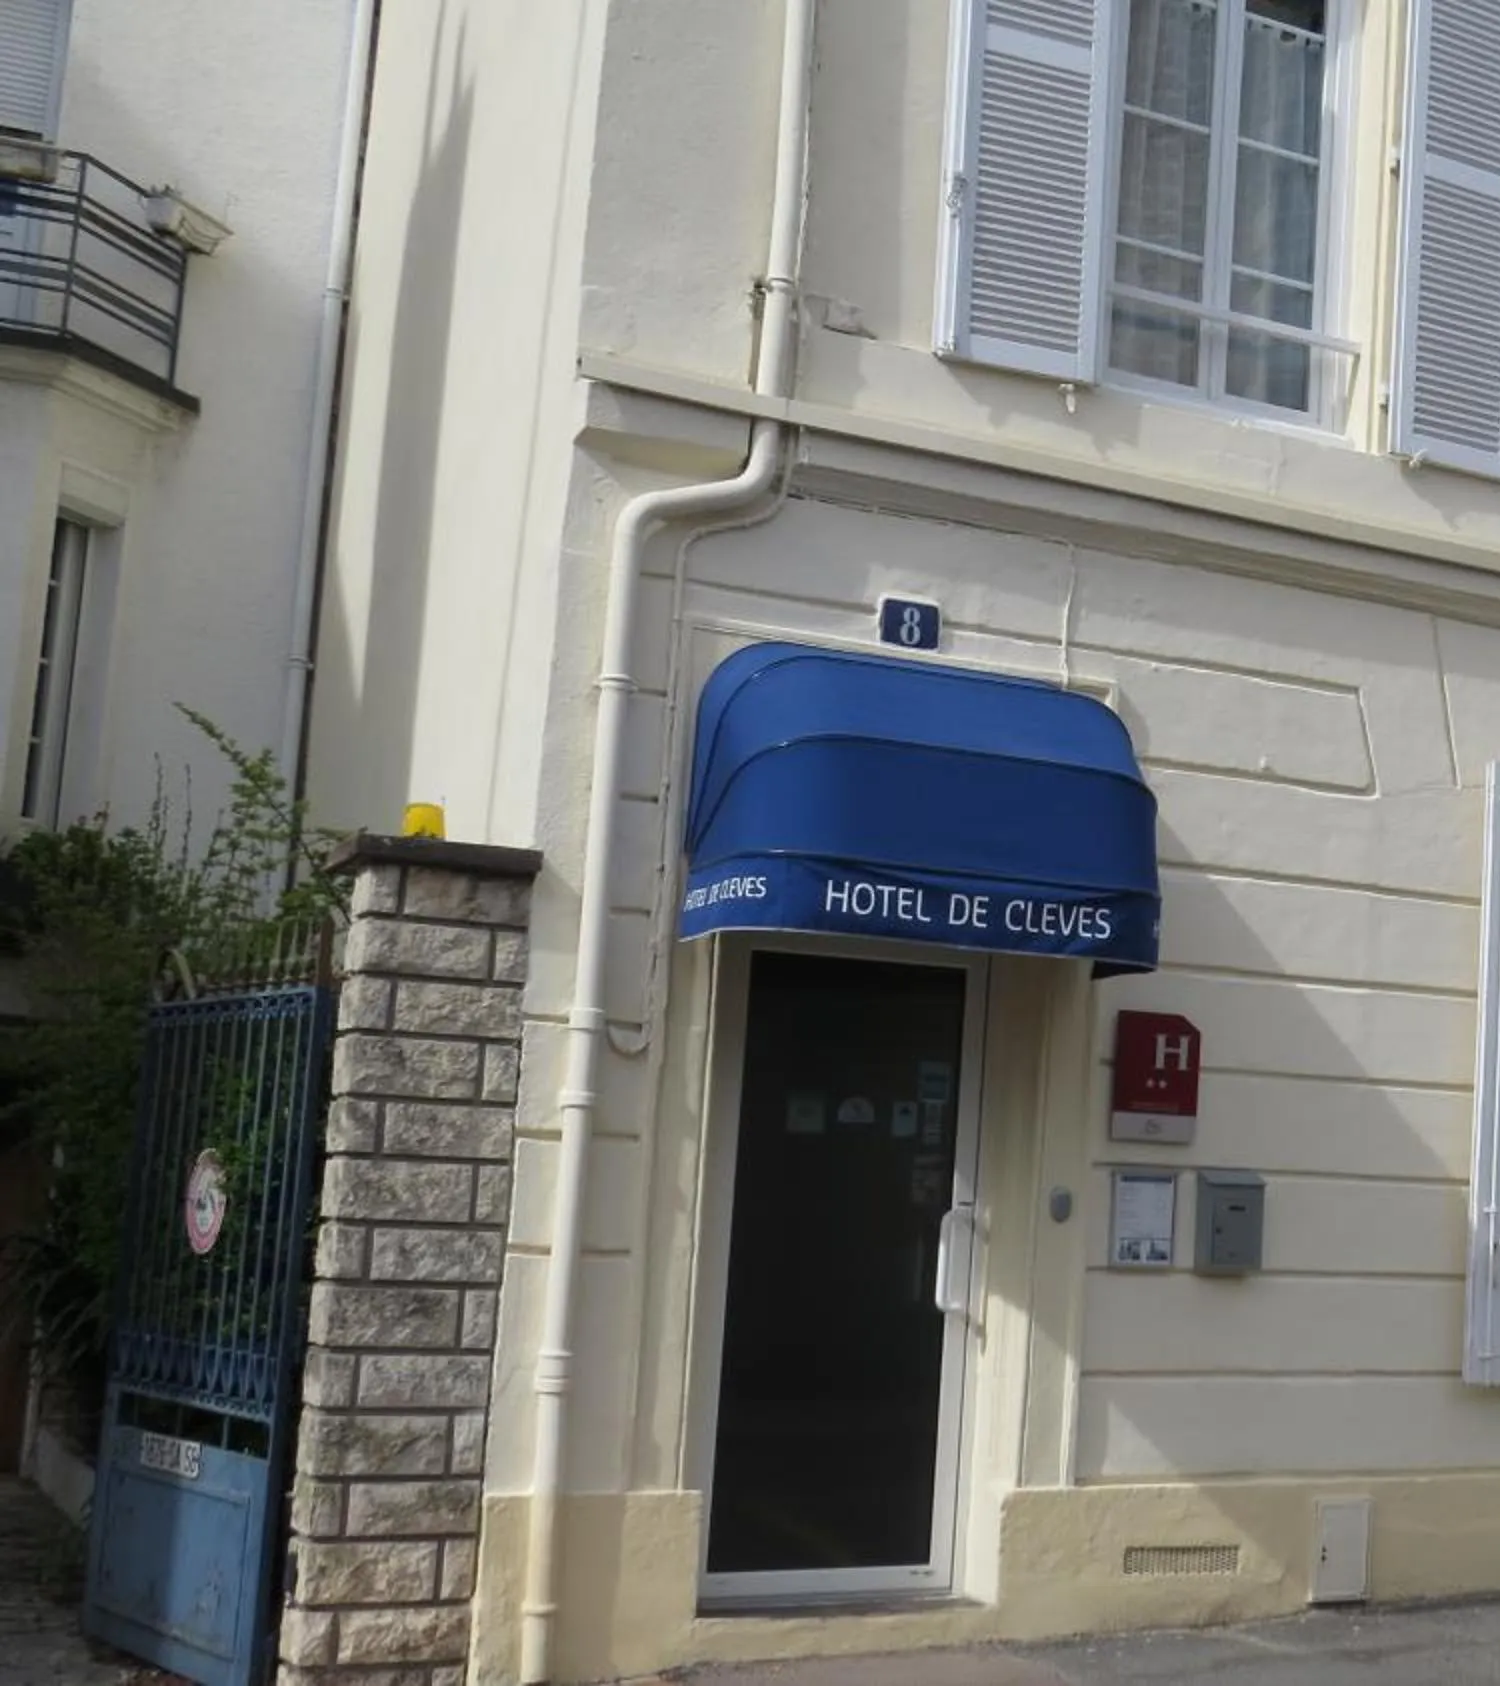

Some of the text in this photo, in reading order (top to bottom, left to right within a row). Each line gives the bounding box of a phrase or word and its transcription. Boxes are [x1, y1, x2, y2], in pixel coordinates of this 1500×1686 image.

[900, 606, 921, 646] 8
[825, 879, 931, 923] HOTEL
[948, 893, 988, 926] DE
[1005, 898, 1112, 939] CLEVES
[1154, 1033, 1191, 1071] H
